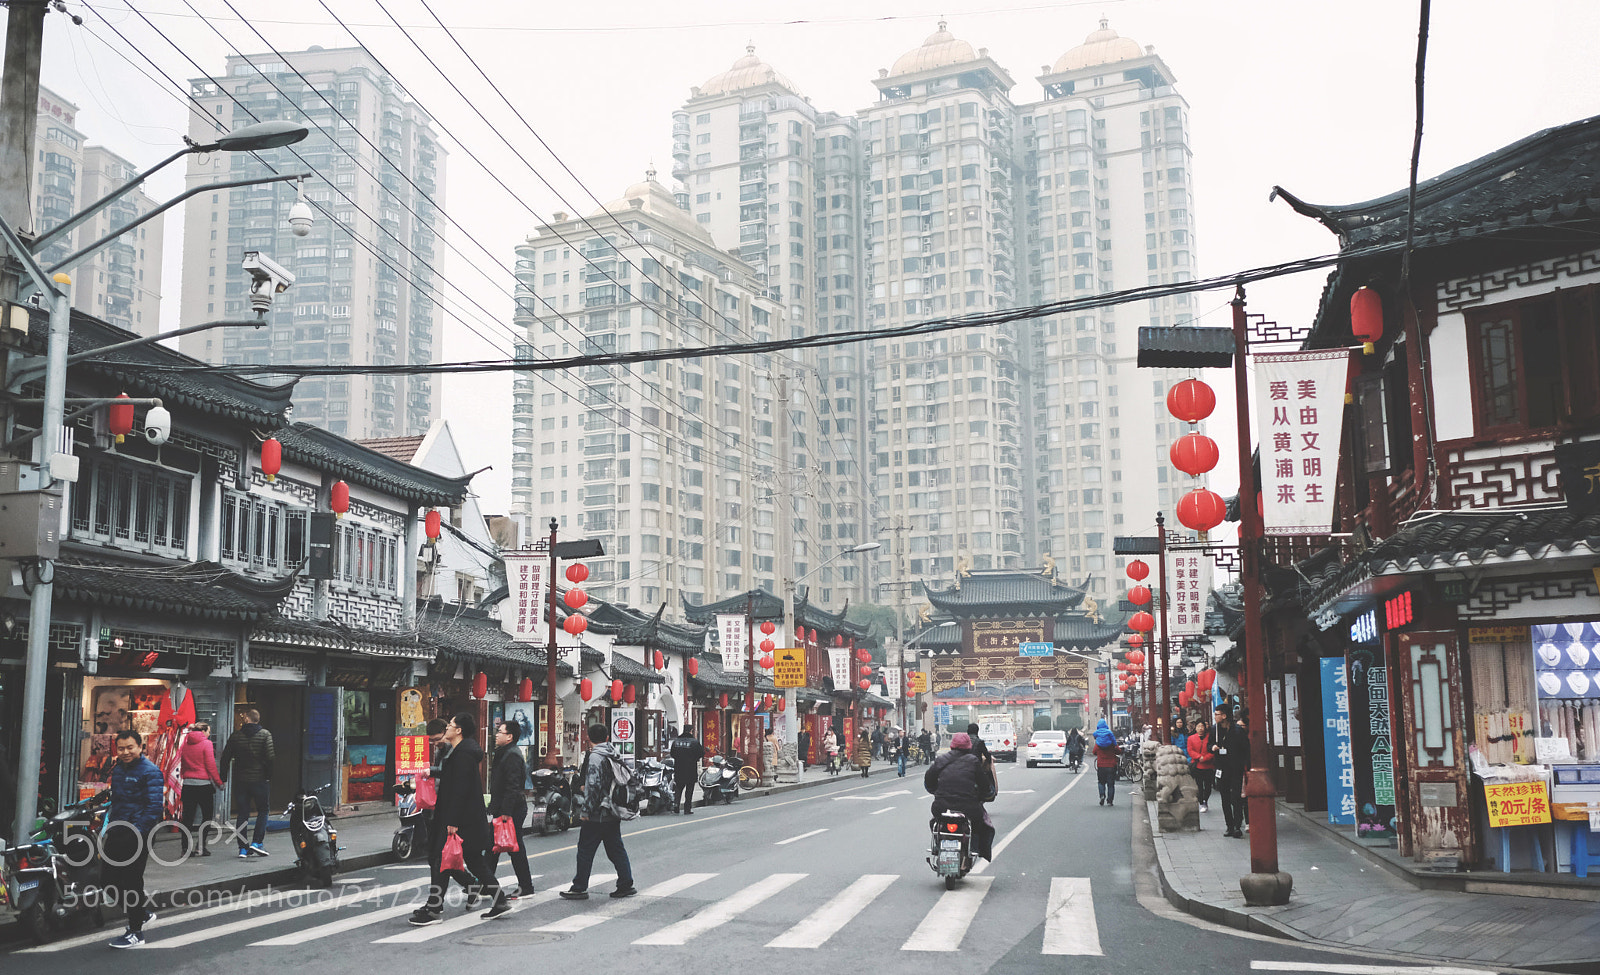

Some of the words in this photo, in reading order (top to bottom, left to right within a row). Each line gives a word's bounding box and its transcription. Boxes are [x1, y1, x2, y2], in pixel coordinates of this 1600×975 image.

[1270, 381, 1296, 504] 爱从黄浦来
[1297, 379, 1324, 503] 美由文明生
[516, 565, 528, 633] 建文明和谐黄浦城
[529, 565, 541, 633] 做明理守信黄浦人
[1176, 558, 1187, 624] 同享美好家园
[1188, 557, 1200, 624] 共建文明黄浦
[1444, 584, 1463, 596] 411
[400, 737, 411, 769] 字画特卖
[414, 737, 425, 768] 画廊升级
[617, 719, 629, 739] 赌石
[1367, 667, 1396, 805] 缅甸天然A货翡翠
[1488, 784, 1544, 798] 天然珍珠
[1490, 801, 1499, 816] 特价
[1500, 797, 1546, 816] 20元/条
